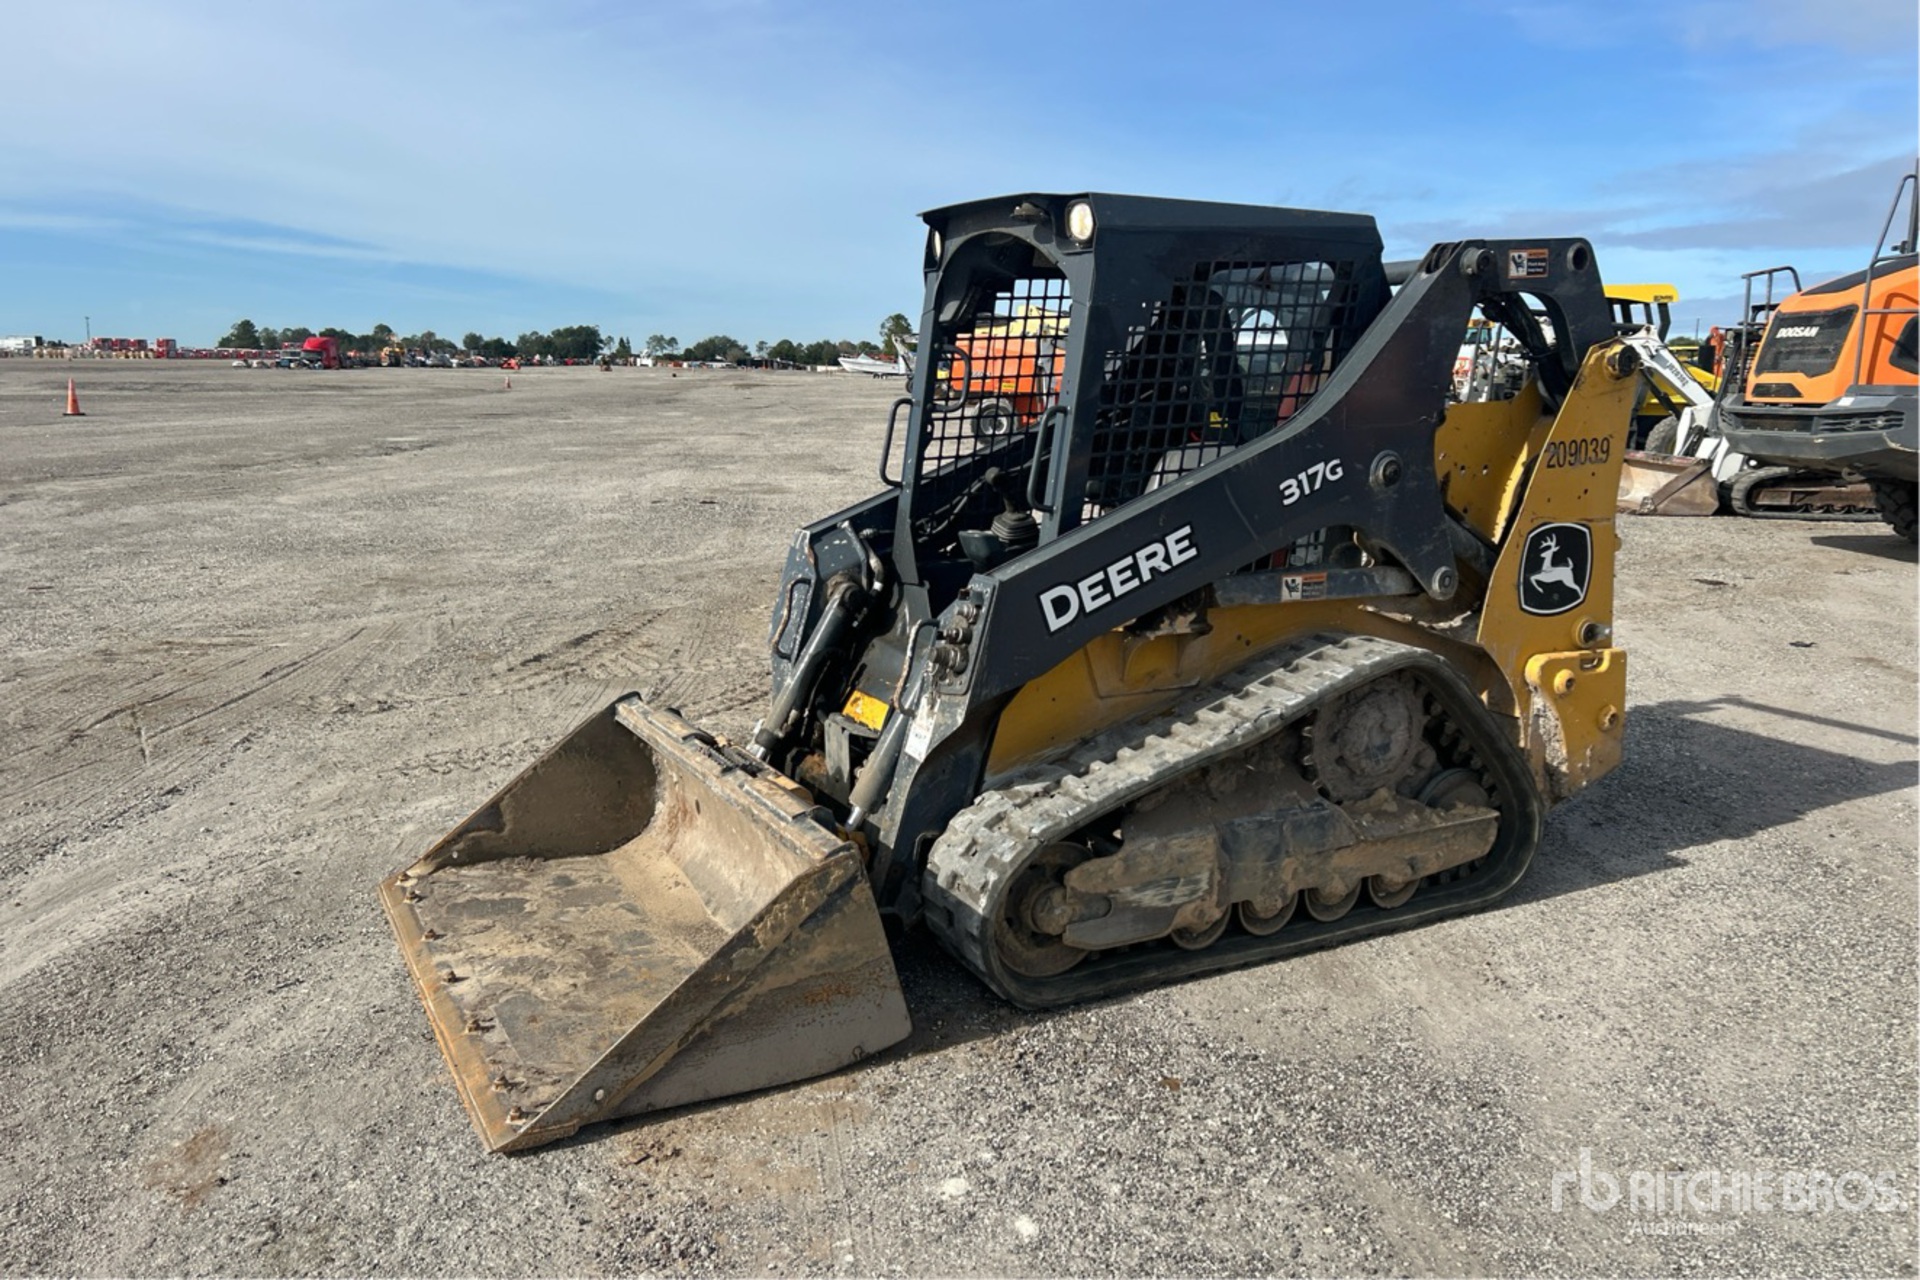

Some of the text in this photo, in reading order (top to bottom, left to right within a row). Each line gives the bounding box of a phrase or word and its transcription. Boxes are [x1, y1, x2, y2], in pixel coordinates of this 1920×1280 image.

[1775, 326, 1820, 338] DOOSAN
[1546, 436, 1611, 469] 209039
[1279, 458, 1344, 506] 317G
[1039, 525, 1198, 633] DEERE
